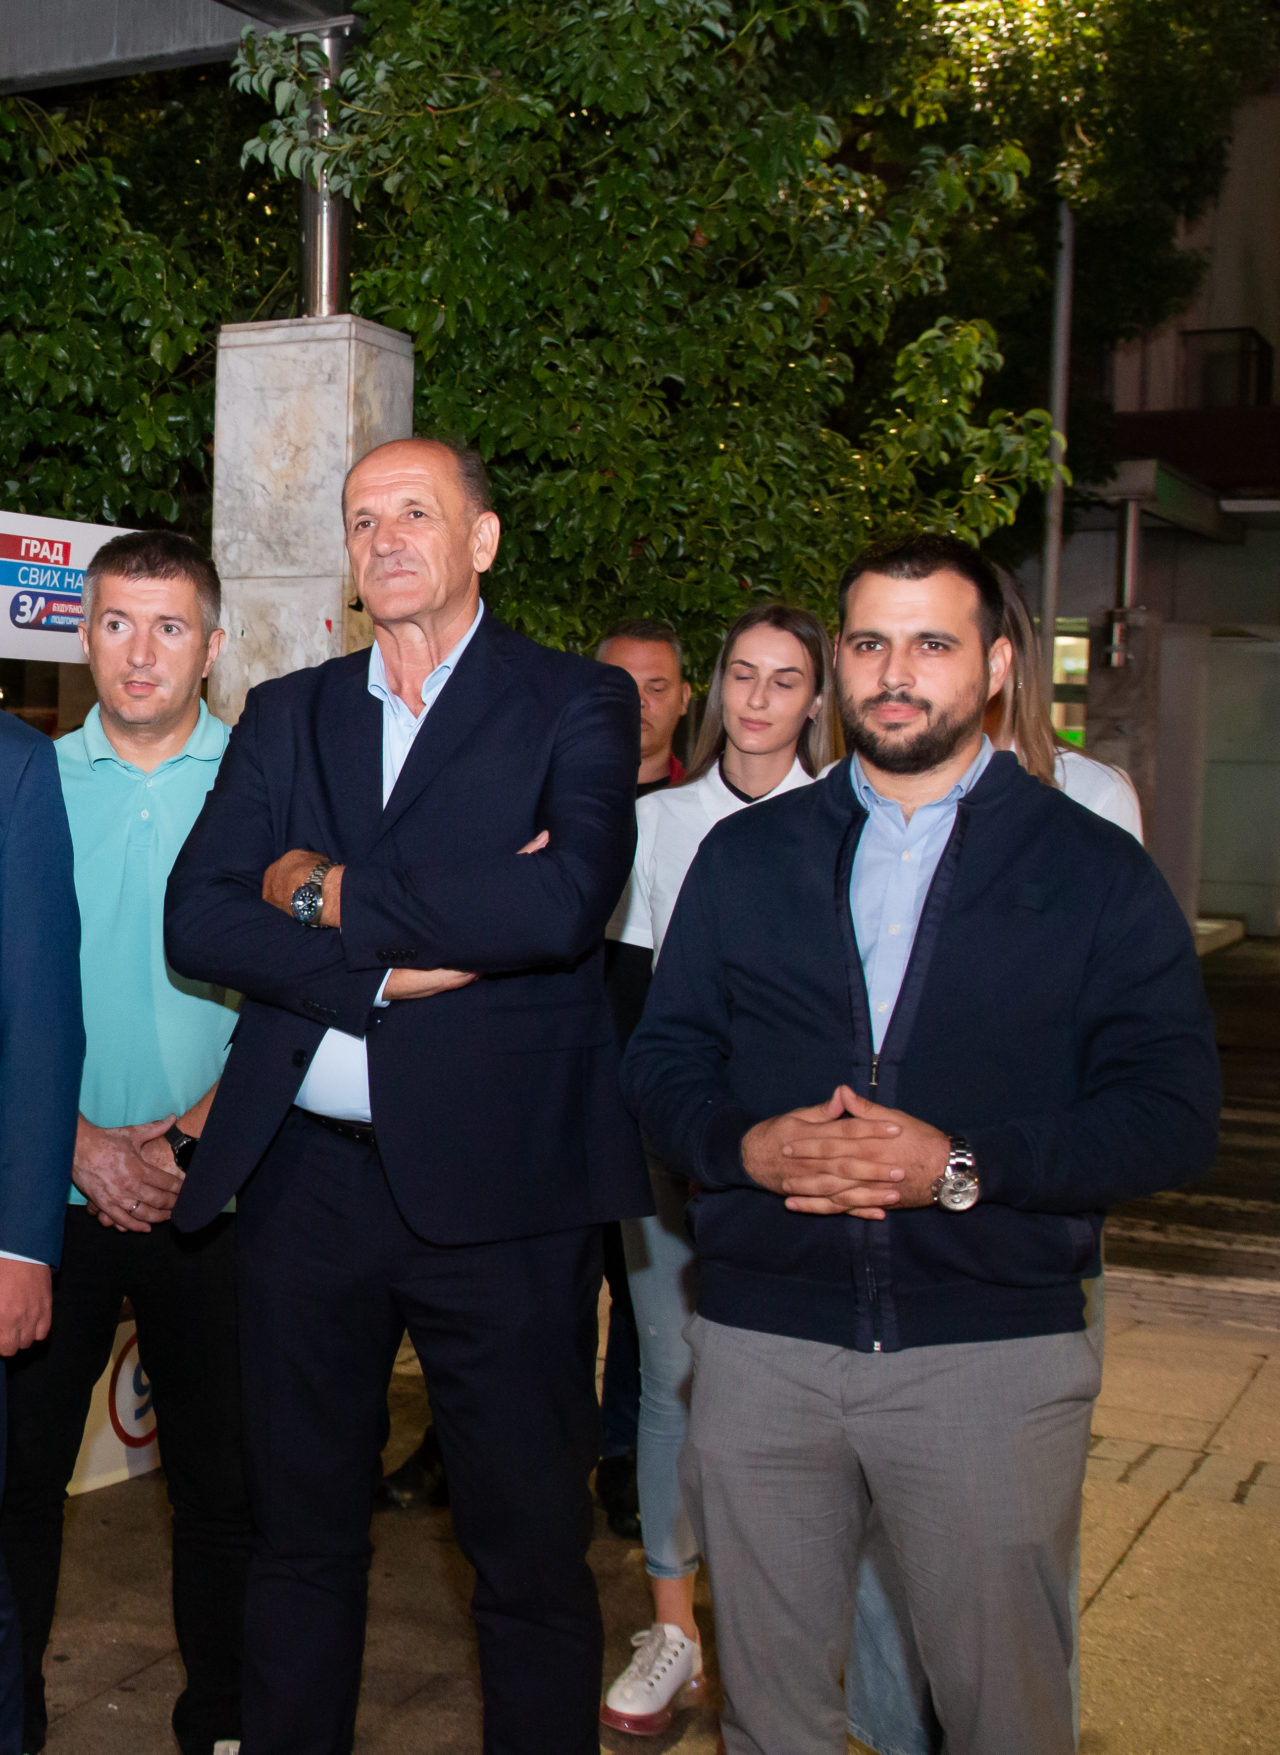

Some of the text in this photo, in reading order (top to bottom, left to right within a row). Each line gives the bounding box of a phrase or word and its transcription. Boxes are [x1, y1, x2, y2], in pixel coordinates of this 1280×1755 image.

[20, 538, 64, 564] ГРАД
[17, 566, 85, 590] СВИХ НА
